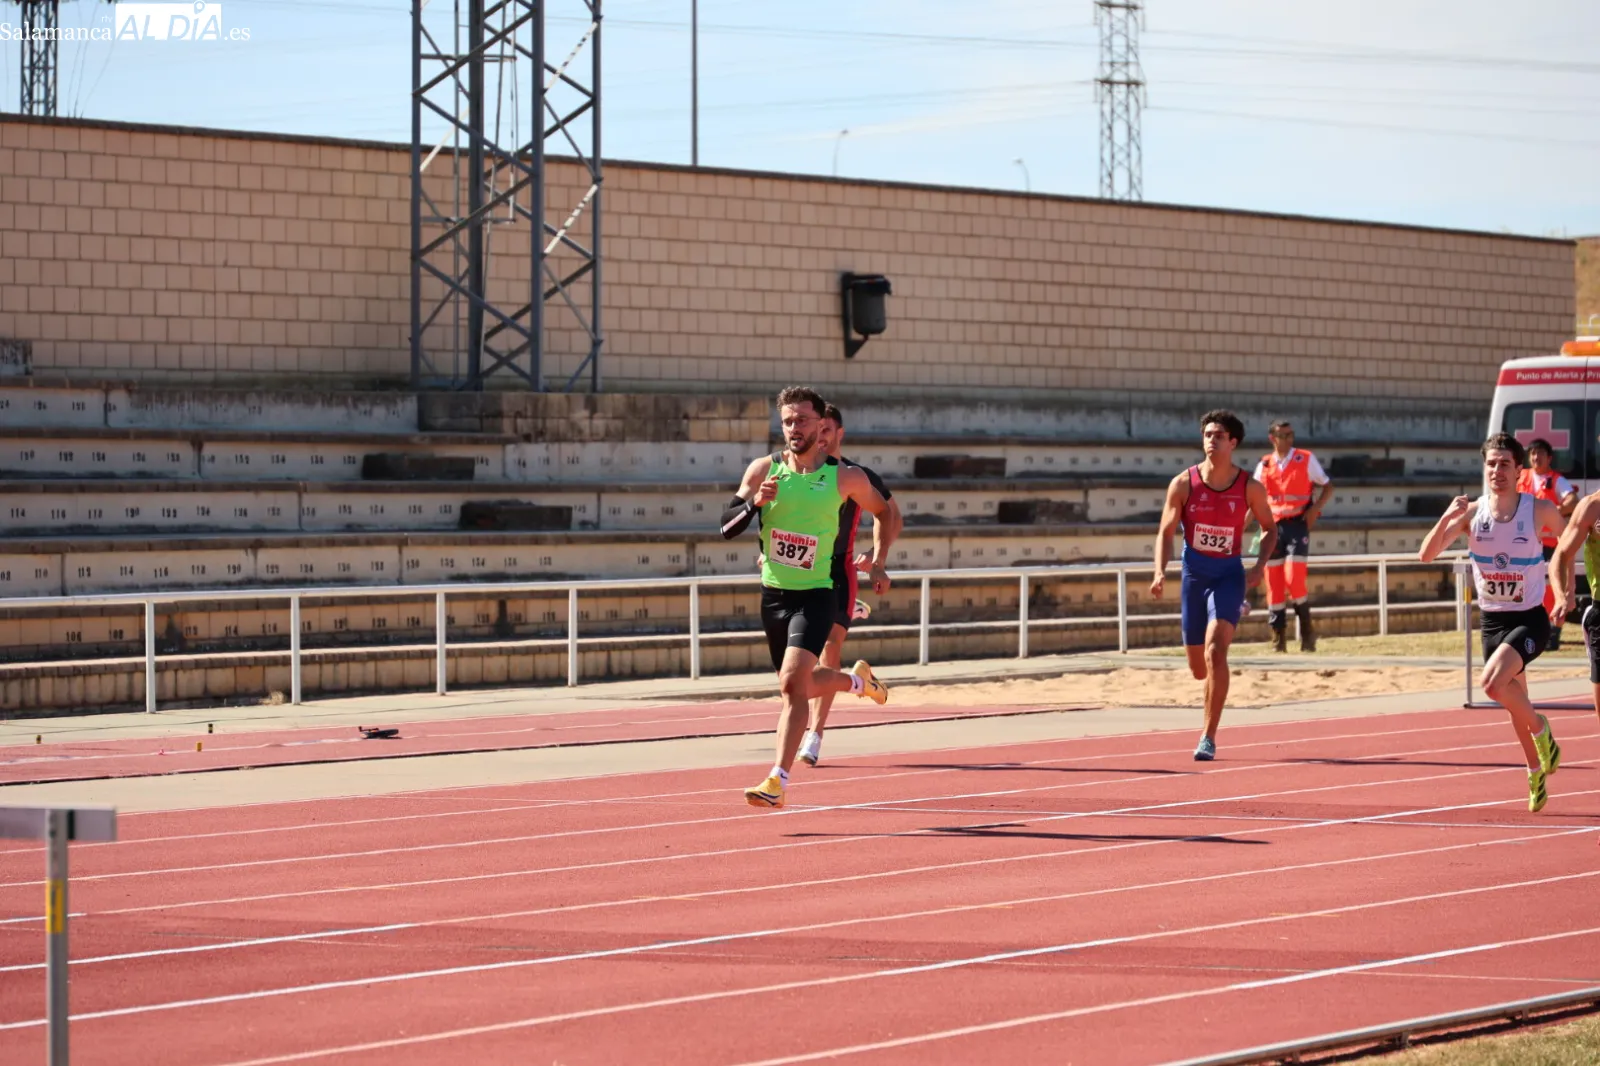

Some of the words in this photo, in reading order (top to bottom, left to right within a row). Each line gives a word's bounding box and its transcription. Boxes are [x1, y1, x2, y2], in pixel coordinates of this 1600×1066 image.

[1516, 372, 1540, 380] Punto
[1541, 372, 1552, 380] de
[1554, 371, 1579, 379] Alerta
[771, 530, 817, 547] bedunia
[1200, 534, 1227, 549] 332
[776, 541, 809, 561] 387
[120, 565, 134, 577] 114
[154, 567, 169, 579] 116
[1487, 581, 1517, 596] 317
[66, 630, 82, 642] 106
